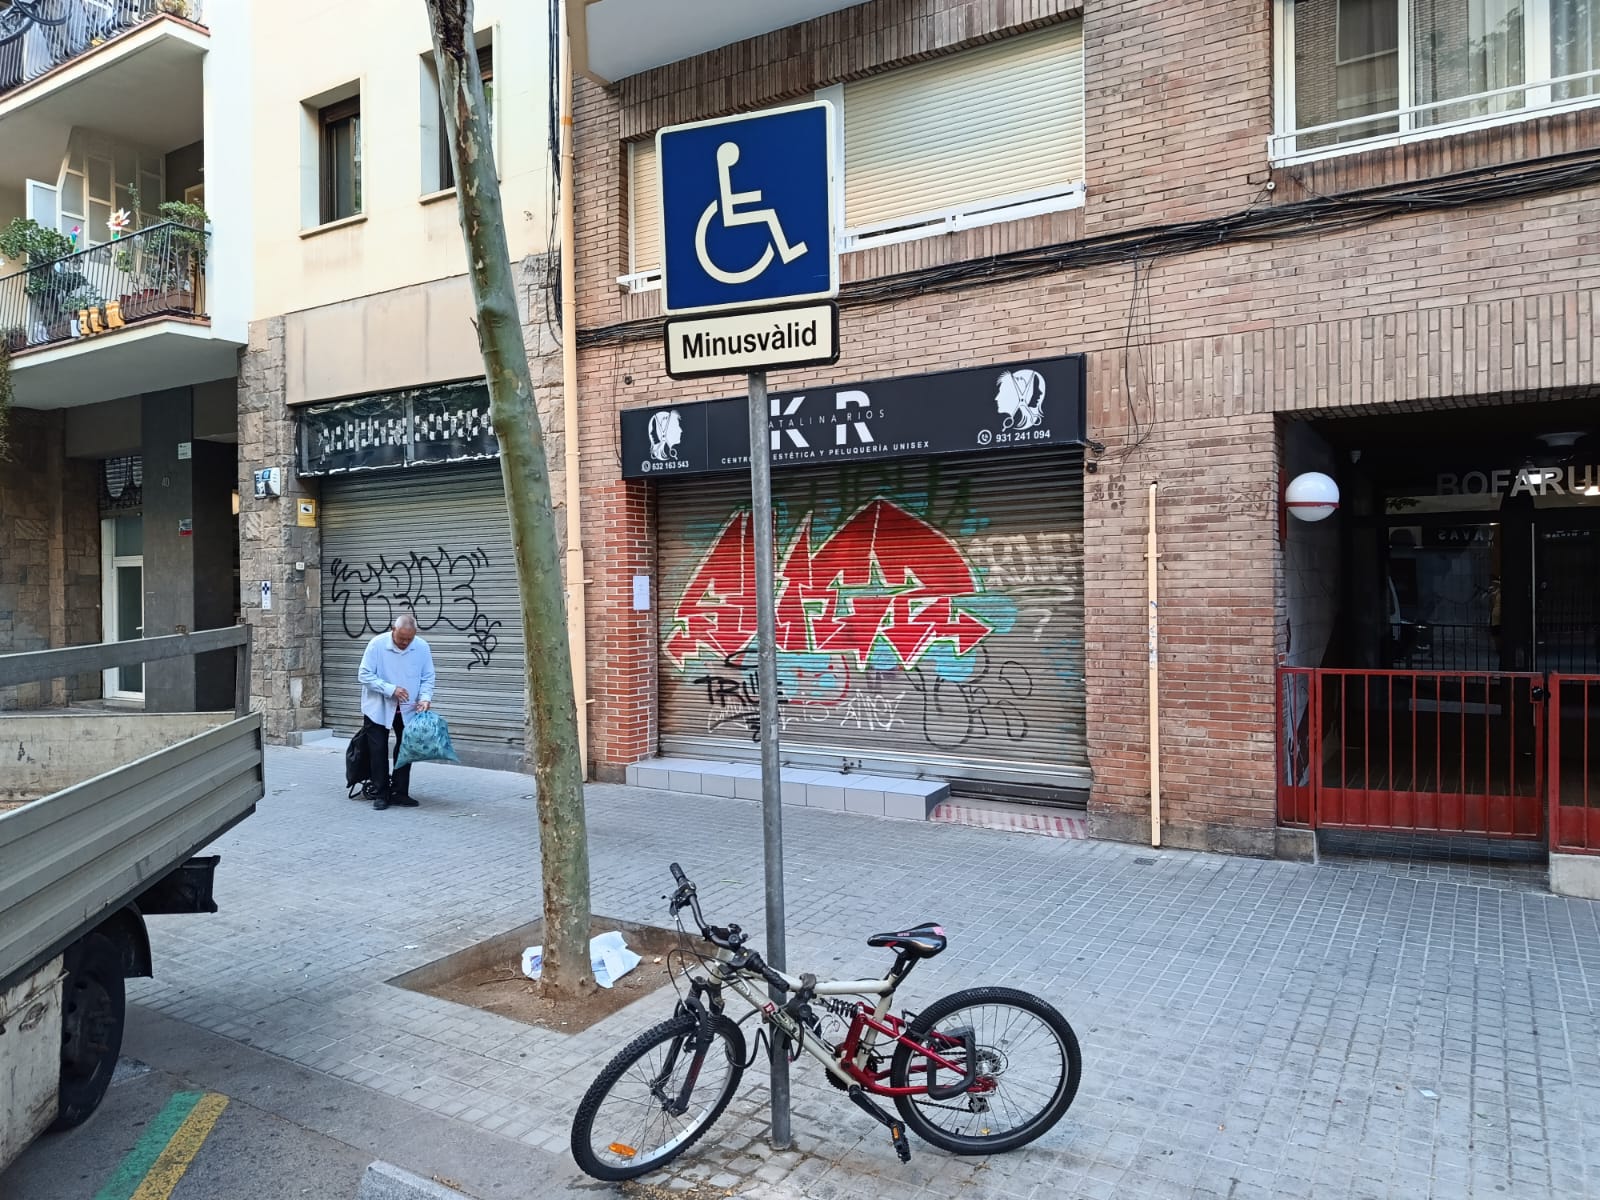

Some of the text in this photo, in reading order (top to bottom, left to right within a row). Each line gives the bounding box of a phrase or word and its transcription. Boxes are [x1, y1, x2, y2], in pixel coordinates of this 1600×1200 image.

[682, 320, 817, 360] Minusvàlid
[768, 409, 886, 429] ATALINA RIOS
[770, 390, 875, 450] K R
[995, 429, 1051, 442] 931 241 094
[772, 451, 815, 461] ESTÉTICA
[828, 444, 888, 456] PELUQUERÍA
[893, 440, 930, 451] UNISEX
[1436, 464, 1600, 498] BOFARU
